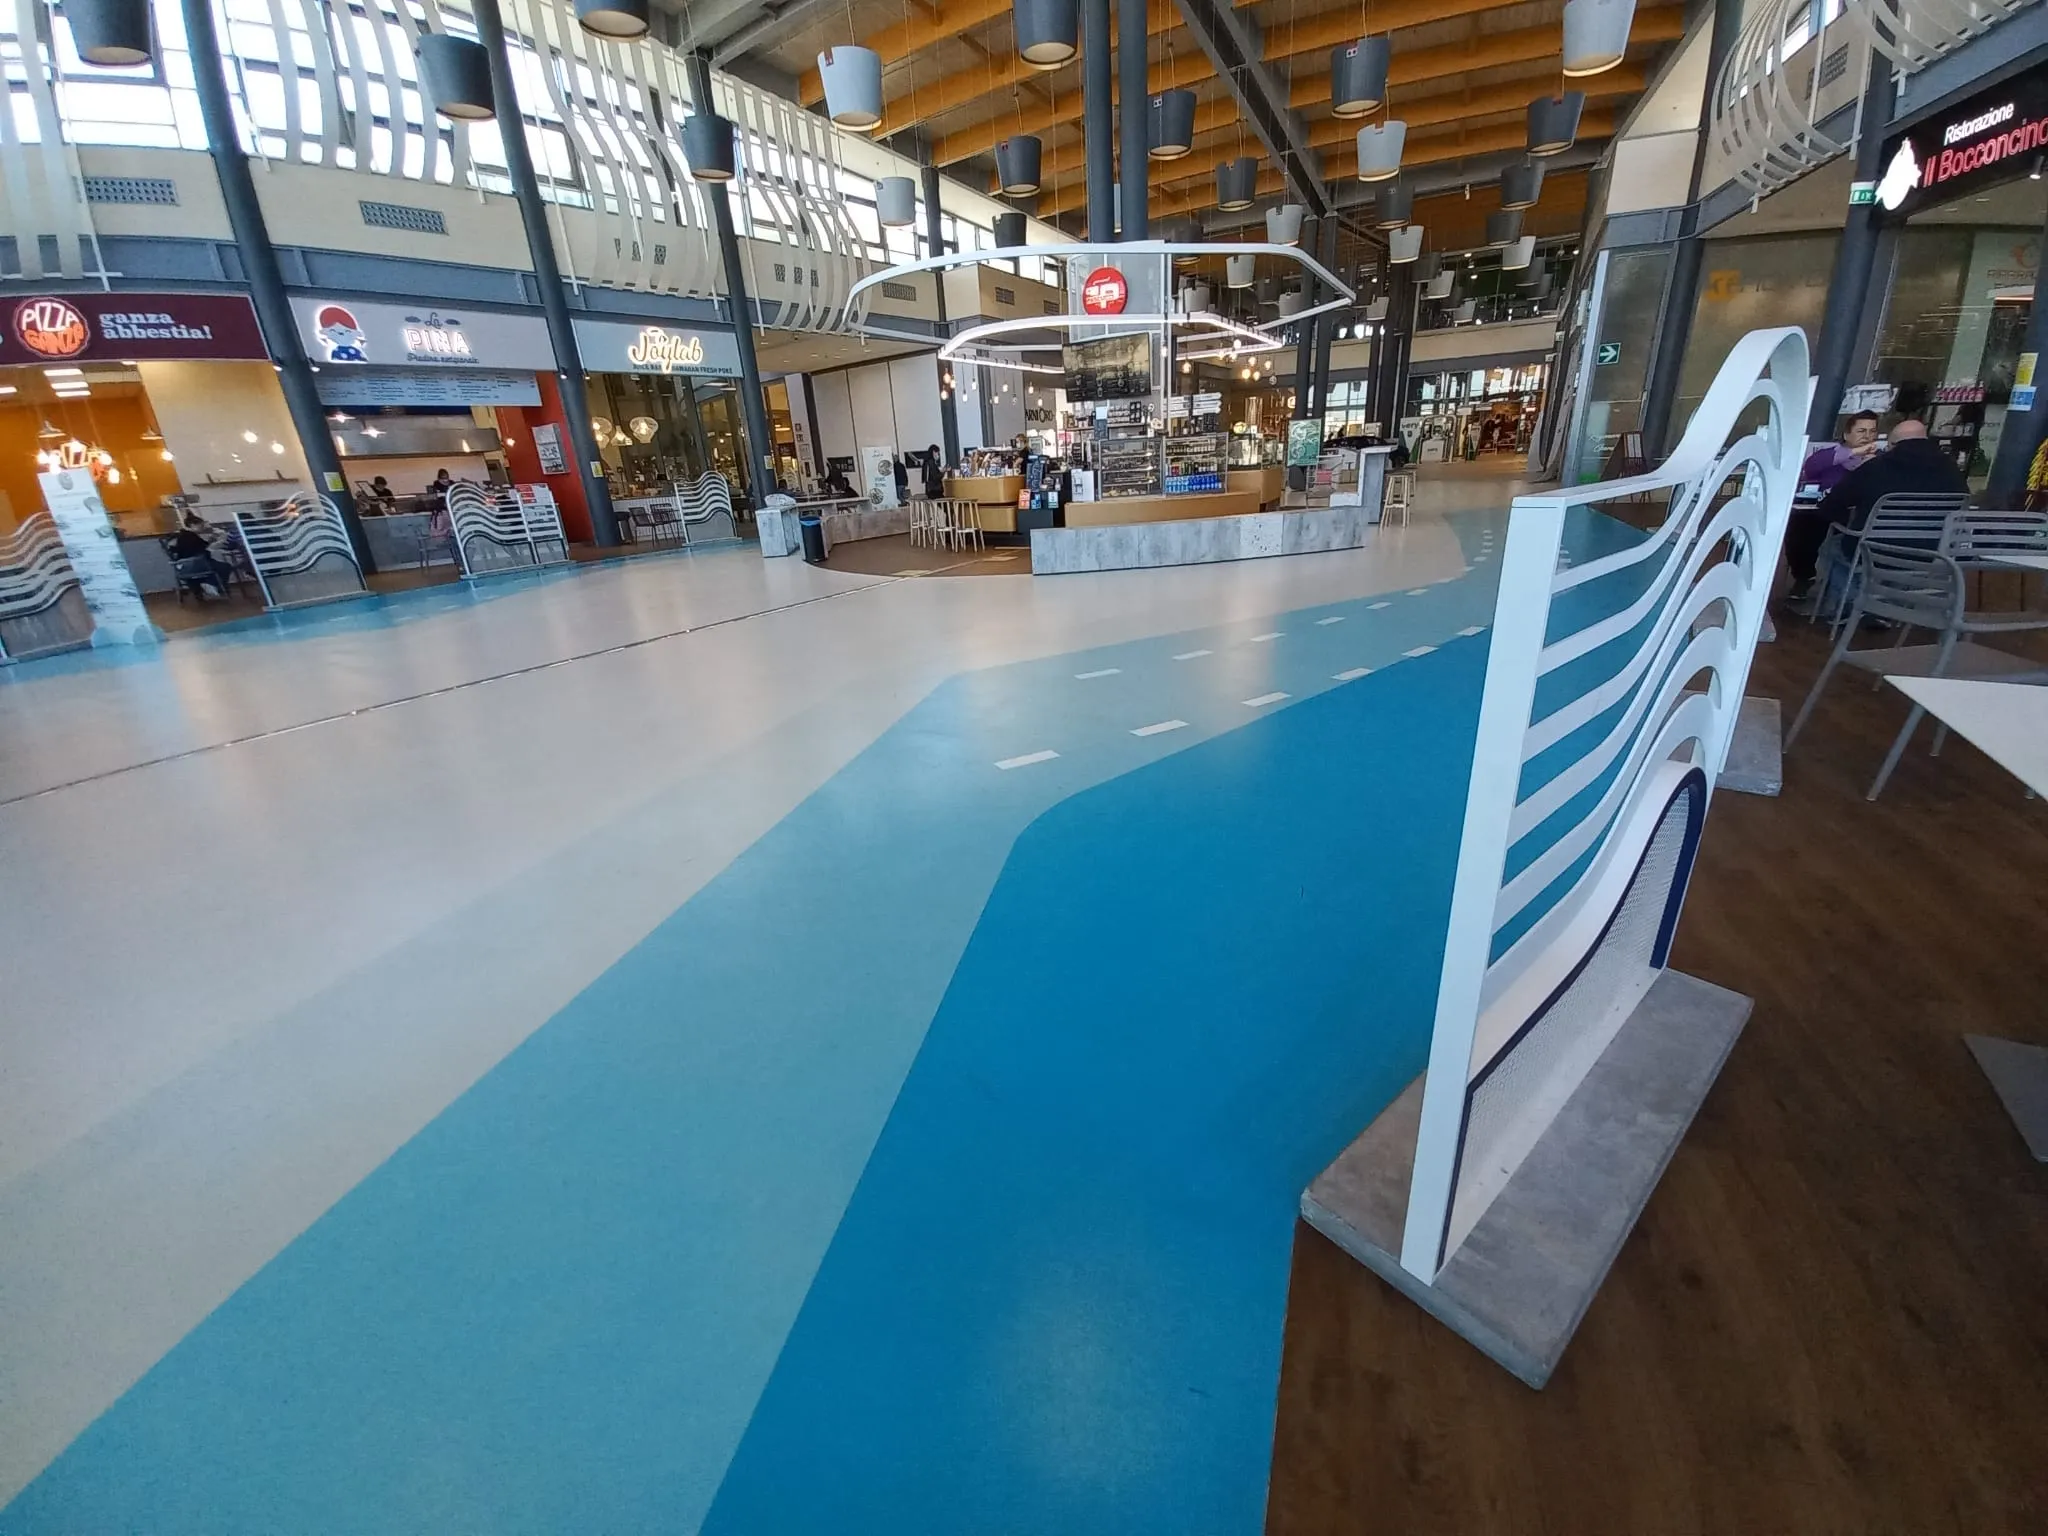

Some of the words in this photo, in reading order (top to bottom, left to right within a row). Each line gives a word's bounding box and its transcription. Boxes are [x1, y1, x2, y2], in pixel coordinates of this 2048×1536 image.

[1944, 103, 2014, 146] Ristorazione
[1923, 156, 1937, 187] Il
[1937, 118, 2048, 183] Bocconcino
[22, 302, 79, 332] PIZZA
[99, 312, 174, 328] ganza
[103, 323, 213, 340] abbestia!
[24, 322, 84, 354] GANZA
[405, 329, 472, 354] PINA
[629, 330, 703, 372] Joylab
[700, 366, 717, 374] FRESH
